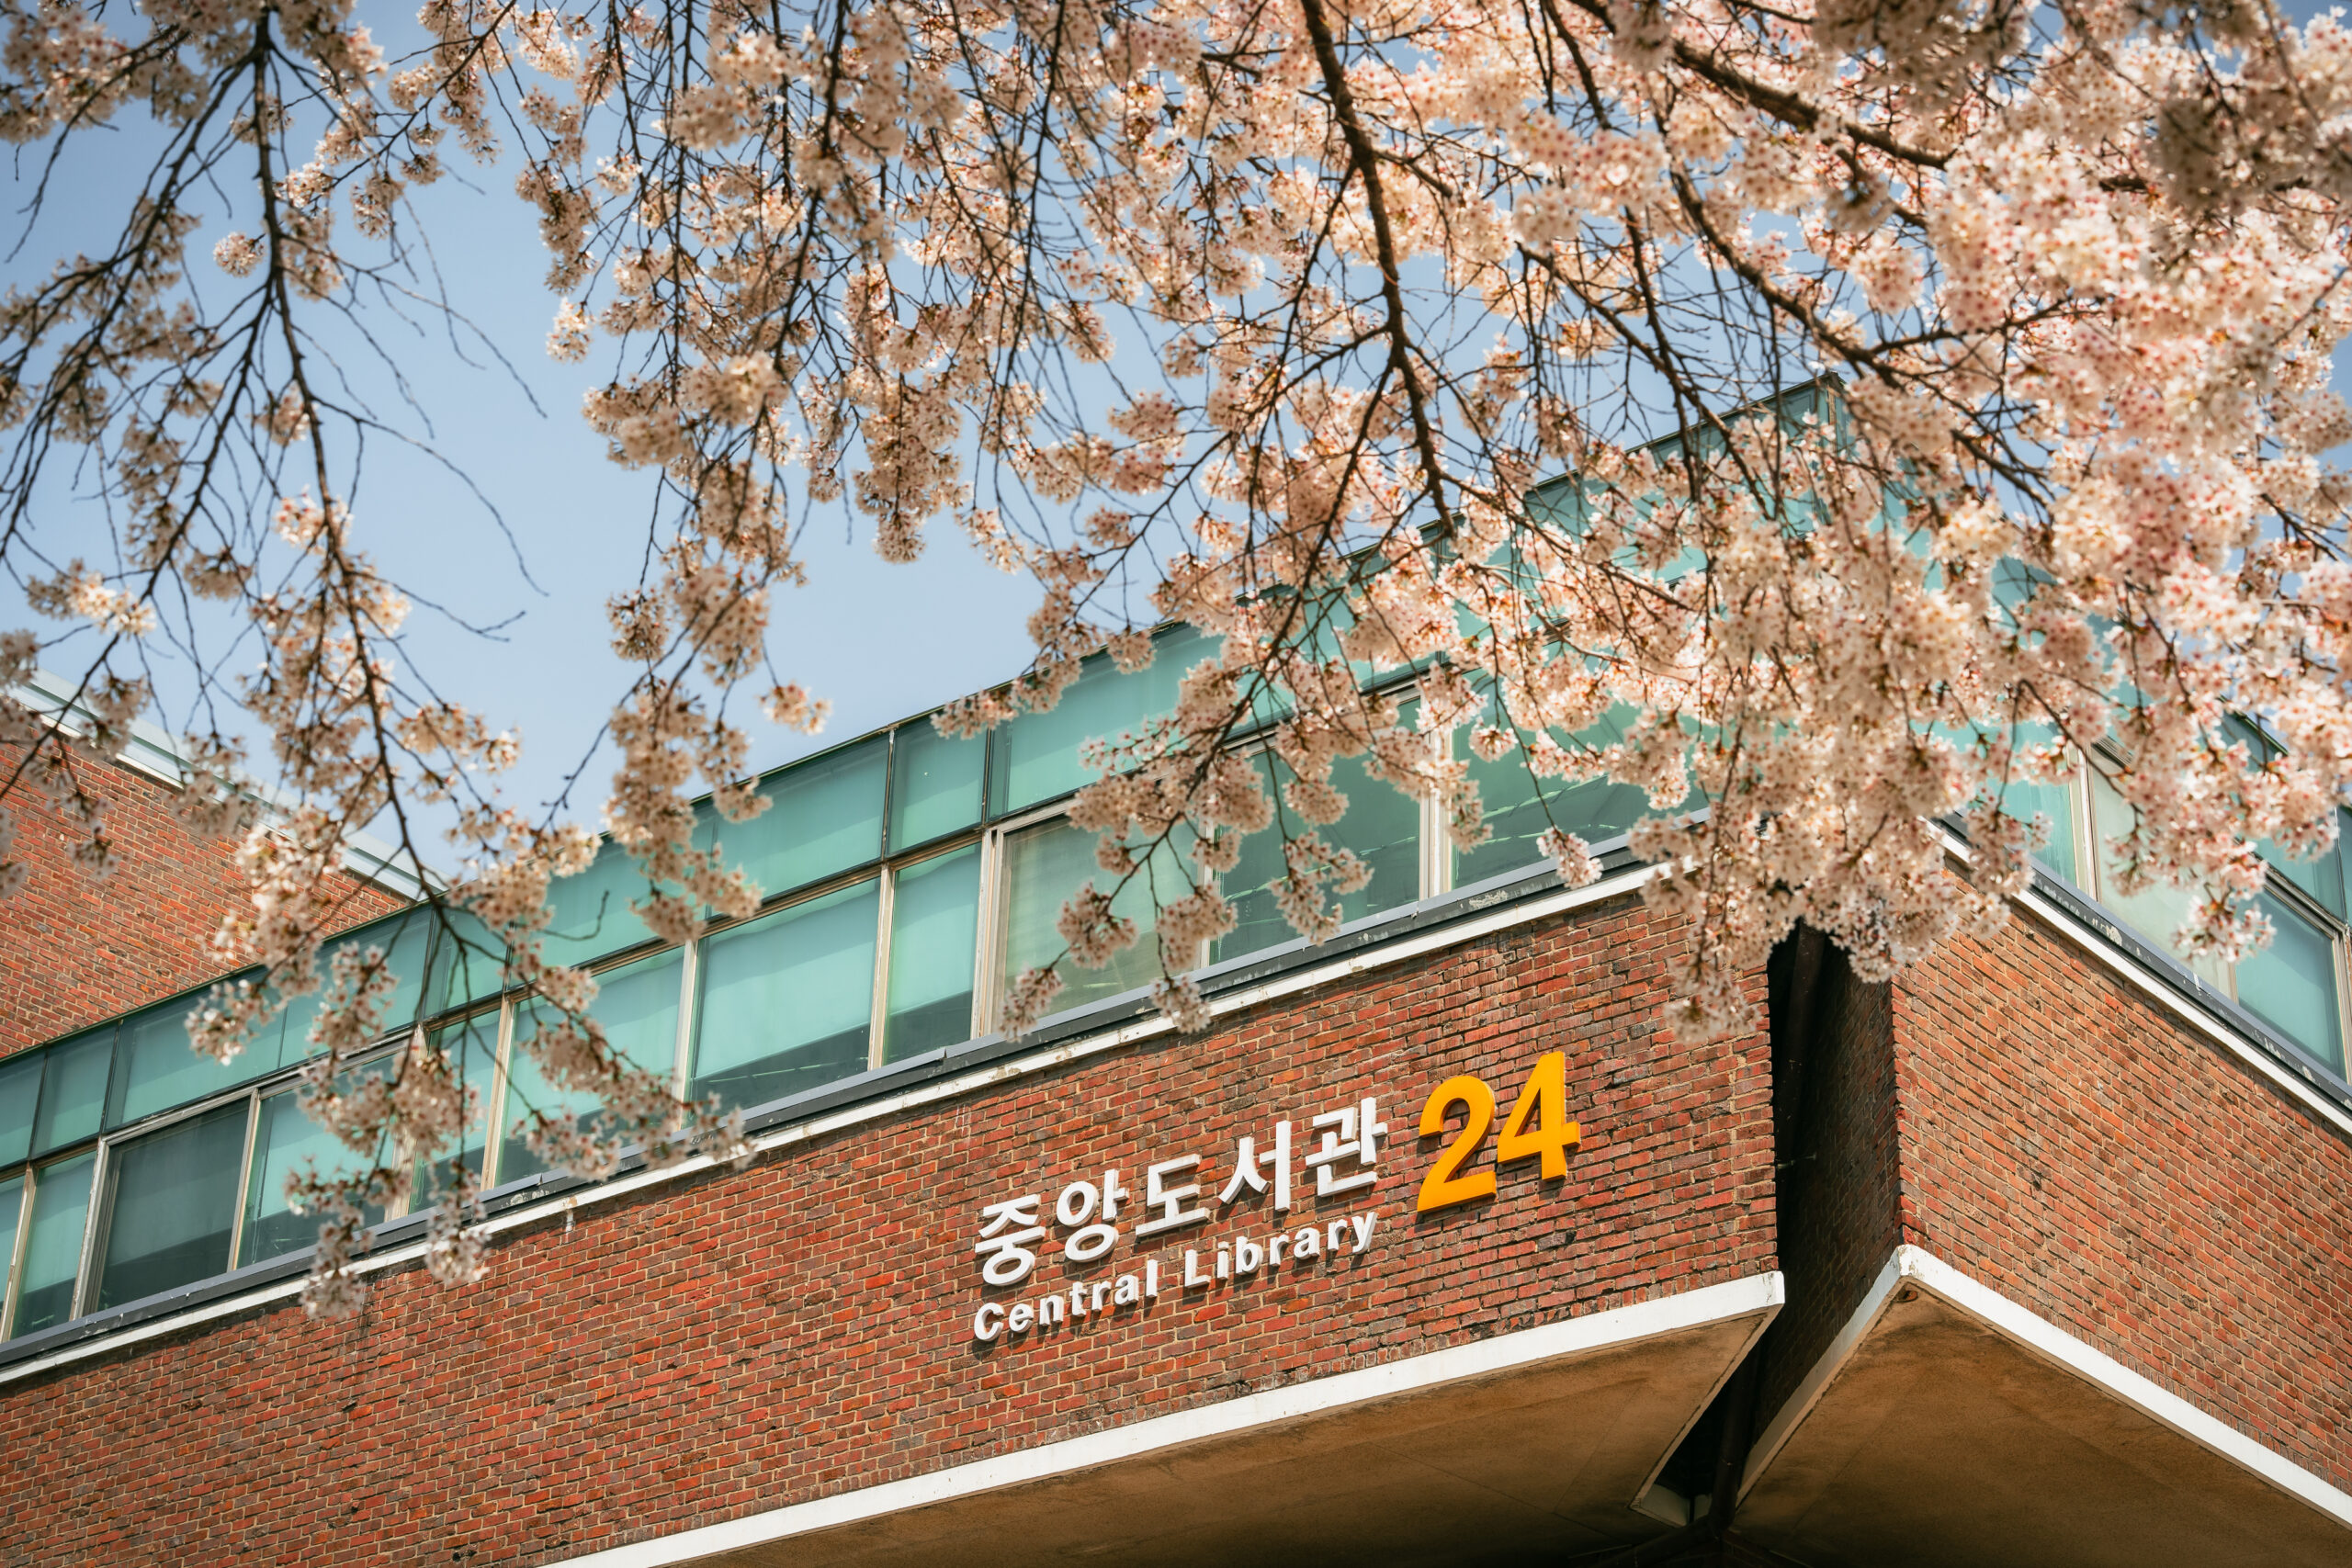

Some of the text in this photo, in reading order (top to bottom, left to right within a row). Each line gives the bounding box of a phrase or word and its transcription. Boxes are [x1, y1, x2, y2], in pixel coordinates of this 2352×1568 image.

[974, 1096, 1388, 1287] 중앙도서관
[1416, 1050, 1582, 1213] 24
[973, 1211, 1378, 1341] Central Library
